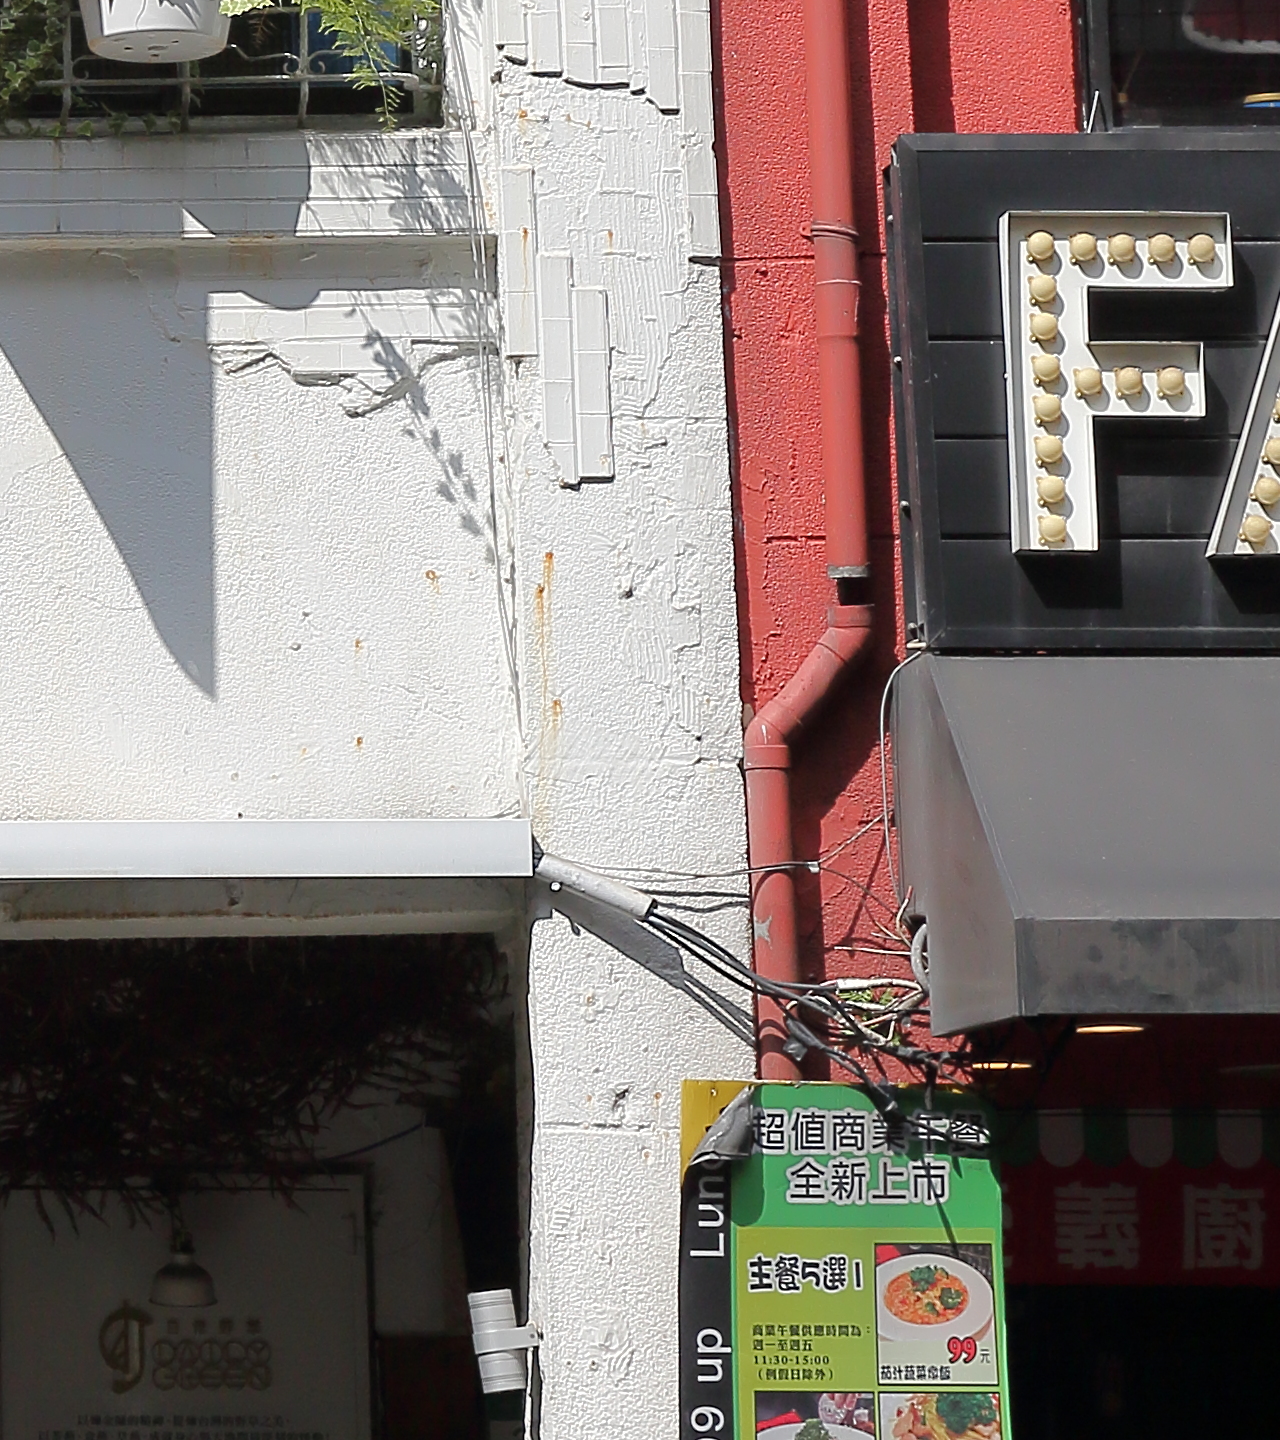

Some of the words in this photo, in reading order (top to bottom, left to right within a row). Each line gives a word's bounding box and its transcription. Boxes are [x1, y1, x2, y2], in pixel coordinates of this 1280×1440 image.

[751, 1110, 990, 1154] 超值商業午餐
[789, 1161, 947, 1201] 全新上市
[1001, 1182, 1267, 1271] 義廚
[748, 1255, 863, 1291] 主餐5選1
[696, 1327, 732, 1383] up
[753, 1339, 813, 1351] 週一至週五
[753, 1355, 830, 1365] 11:30-15:00
